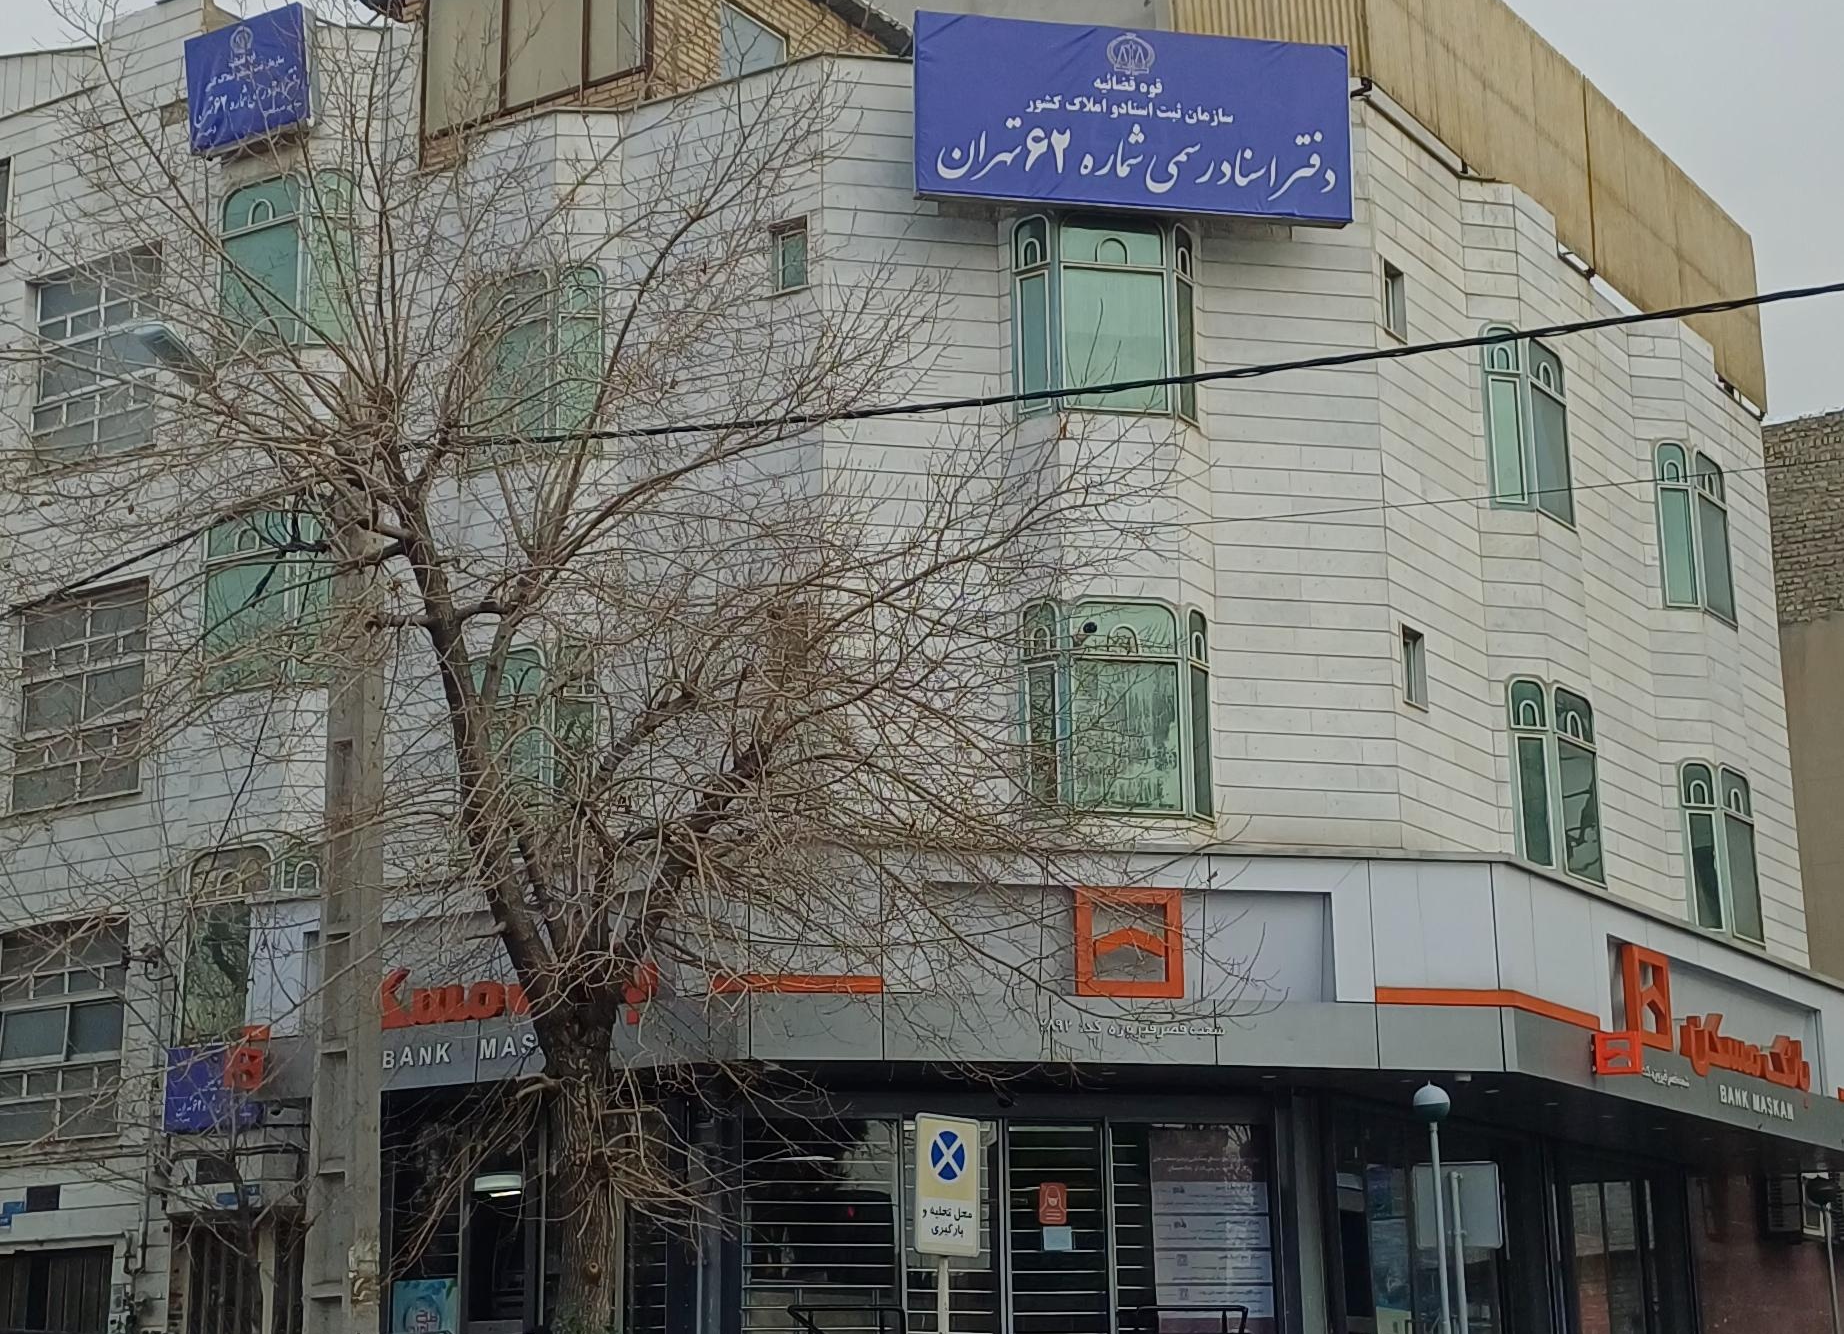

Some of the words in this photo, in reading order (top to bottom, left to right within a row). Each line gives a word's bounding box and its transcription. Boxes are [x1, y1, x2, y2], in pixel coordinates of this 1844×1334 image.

[1093, 73, 1136, 94] قضائیه
[1140, 78, 1163, 98] قوه
[1025, 94, 1062, 113] کشور
[1065, 96, 1107, 113] املاک
[1156, 102, 1182, 123] ثبت
[1185, 105, 1234, 126] سازمان
[937, 117, 1023, 181] تهران
[1024, 127, 1071, 174] ۶۲
[1079, 123, 1145, 179] شماره
[1145, 143, 1215, 194] رسمی
[1216, 148, 1277, 188] اسناد
[1267, 130, 1336, 202] دفتر
[382, 1042, 450, 1070] BANK
[1680, 1013, 1761, 1077] مسکن
[1759, 1034, 1811, 1092] بانک
[1719, 1084, 1749, 1109] BANK
[1752, 1093, 1794, 1121] MASKAN
[922, 1208, 928, 1218] و
[930, 1206, 952, 1219] تخلیه
[954, 1207, 973, 1221] محل
[931, 1223, 964, 1238] بارگیری
